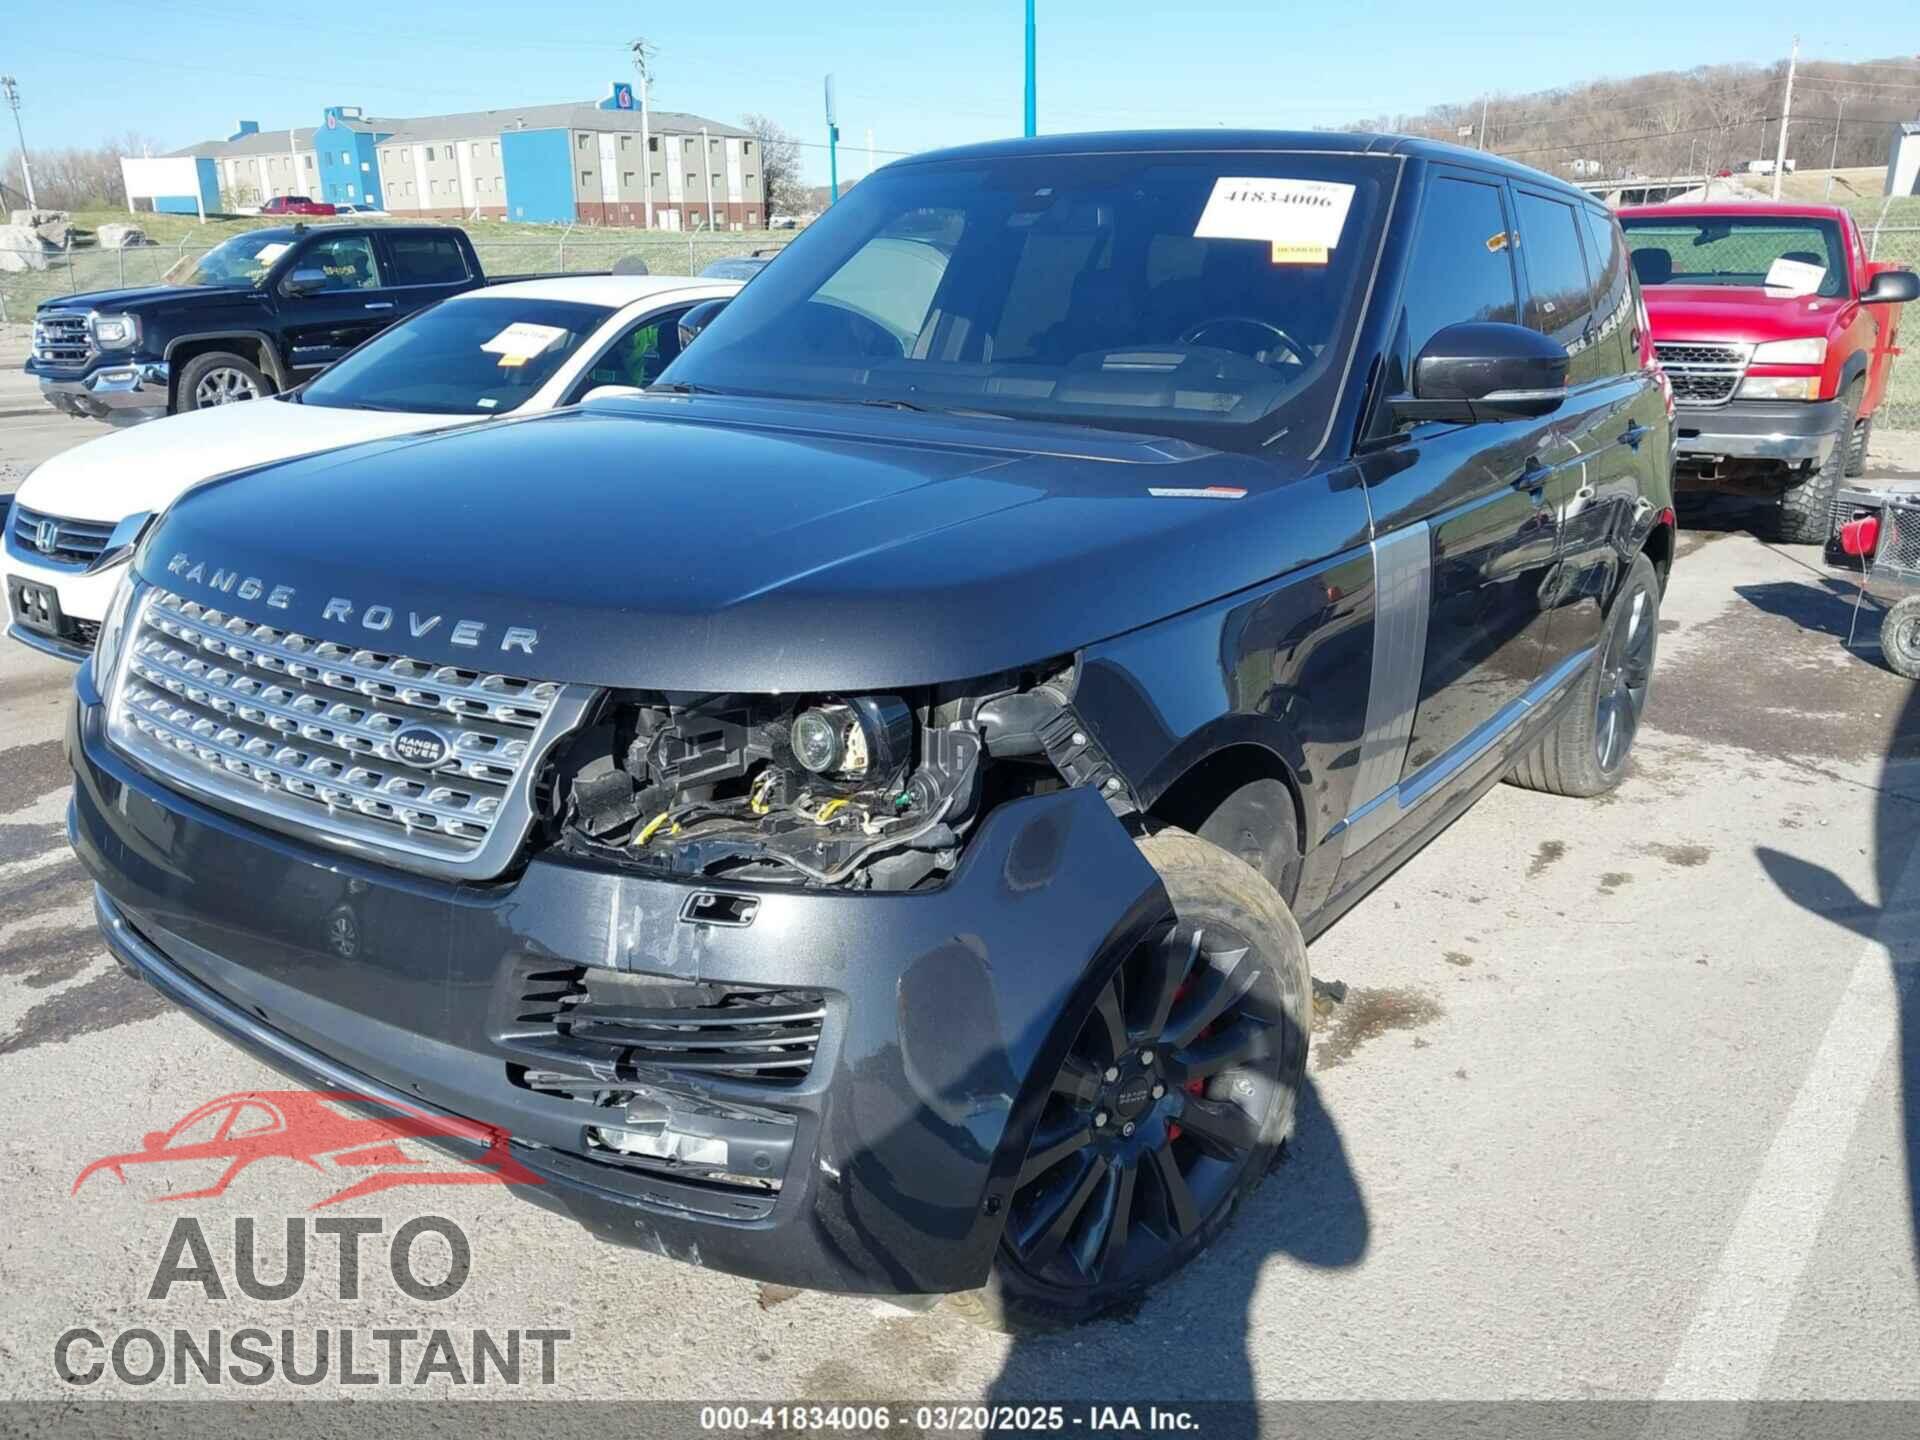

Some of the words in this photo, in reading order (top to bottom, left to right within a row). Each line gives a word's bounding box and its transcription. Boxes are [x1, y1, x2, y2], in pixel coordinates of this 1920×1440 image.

[1224, 191, 1332, 207] 41834006
[167, 552, 296, 609] RANGE
[322, 597, 539, 654] ROVER
[398, 743, 439, 760] ROVER
[400, 736, 440, 751] RANGE
